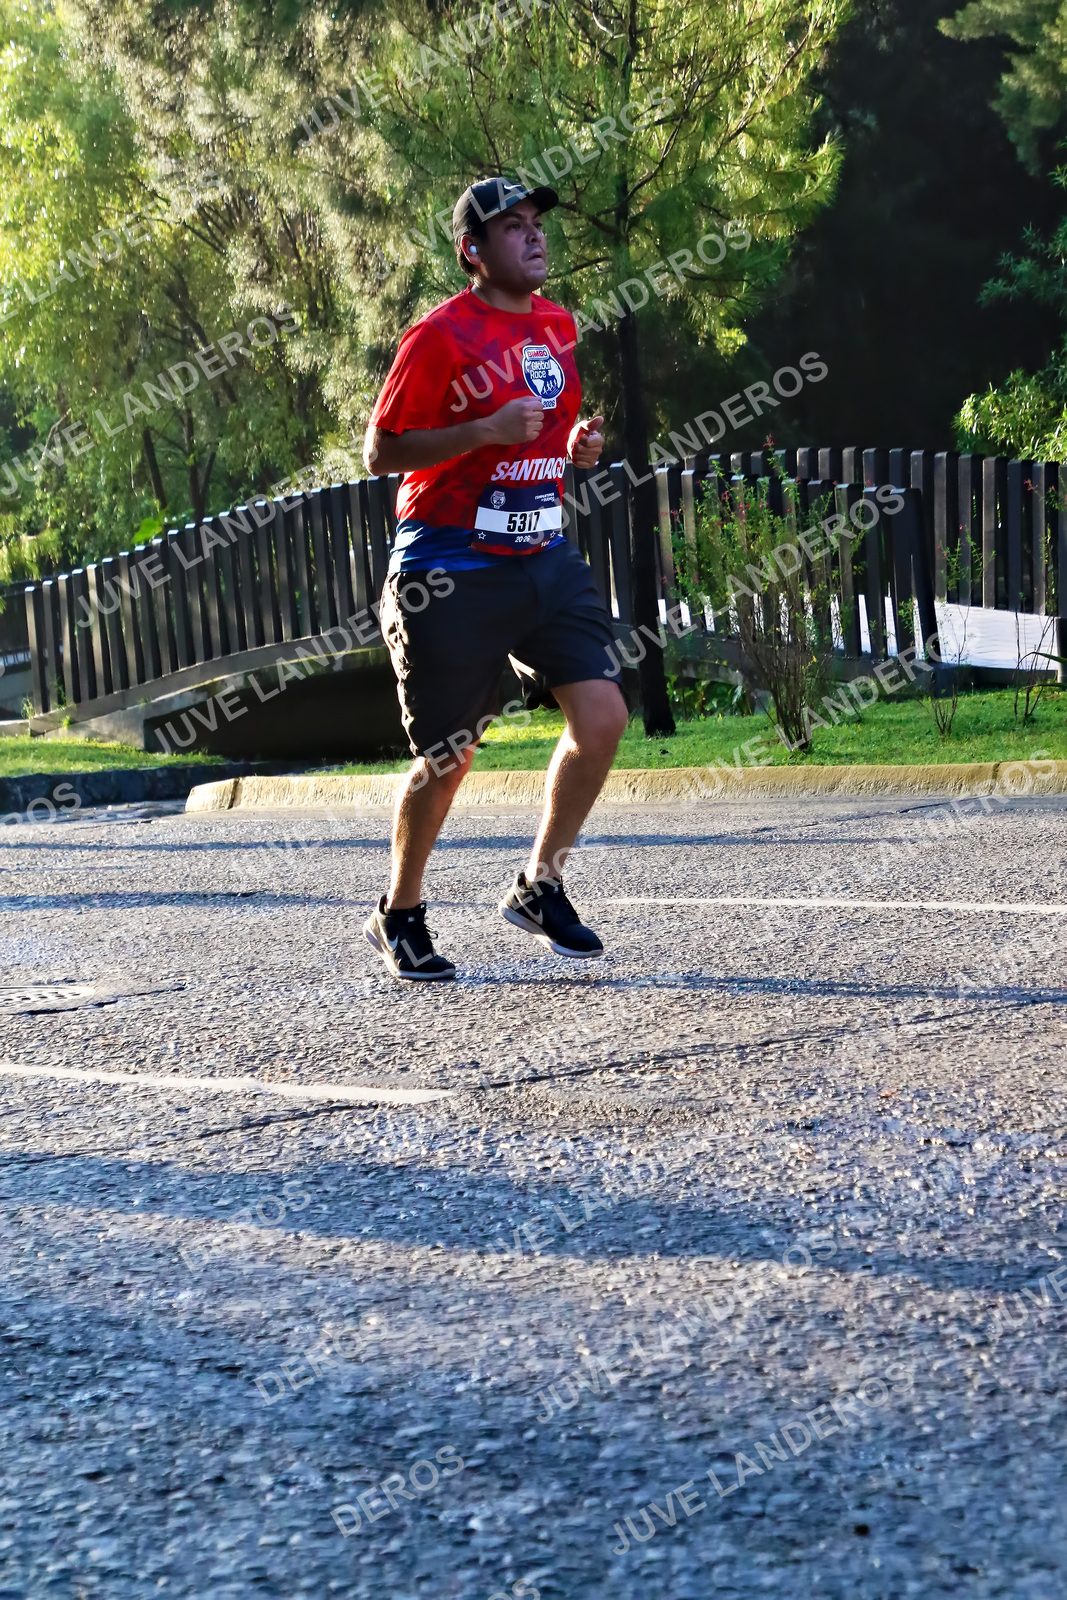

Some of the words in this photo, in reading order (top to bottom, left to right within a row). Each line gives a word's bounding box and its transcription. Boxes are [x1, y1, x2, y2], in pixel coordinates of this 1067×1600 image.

[531, 360, 551, 371] Global
[530, 370, 547, 380] Race
[490, 456, 566, 481] SANTIAGO
[506, 511, 541, 533] 5317
